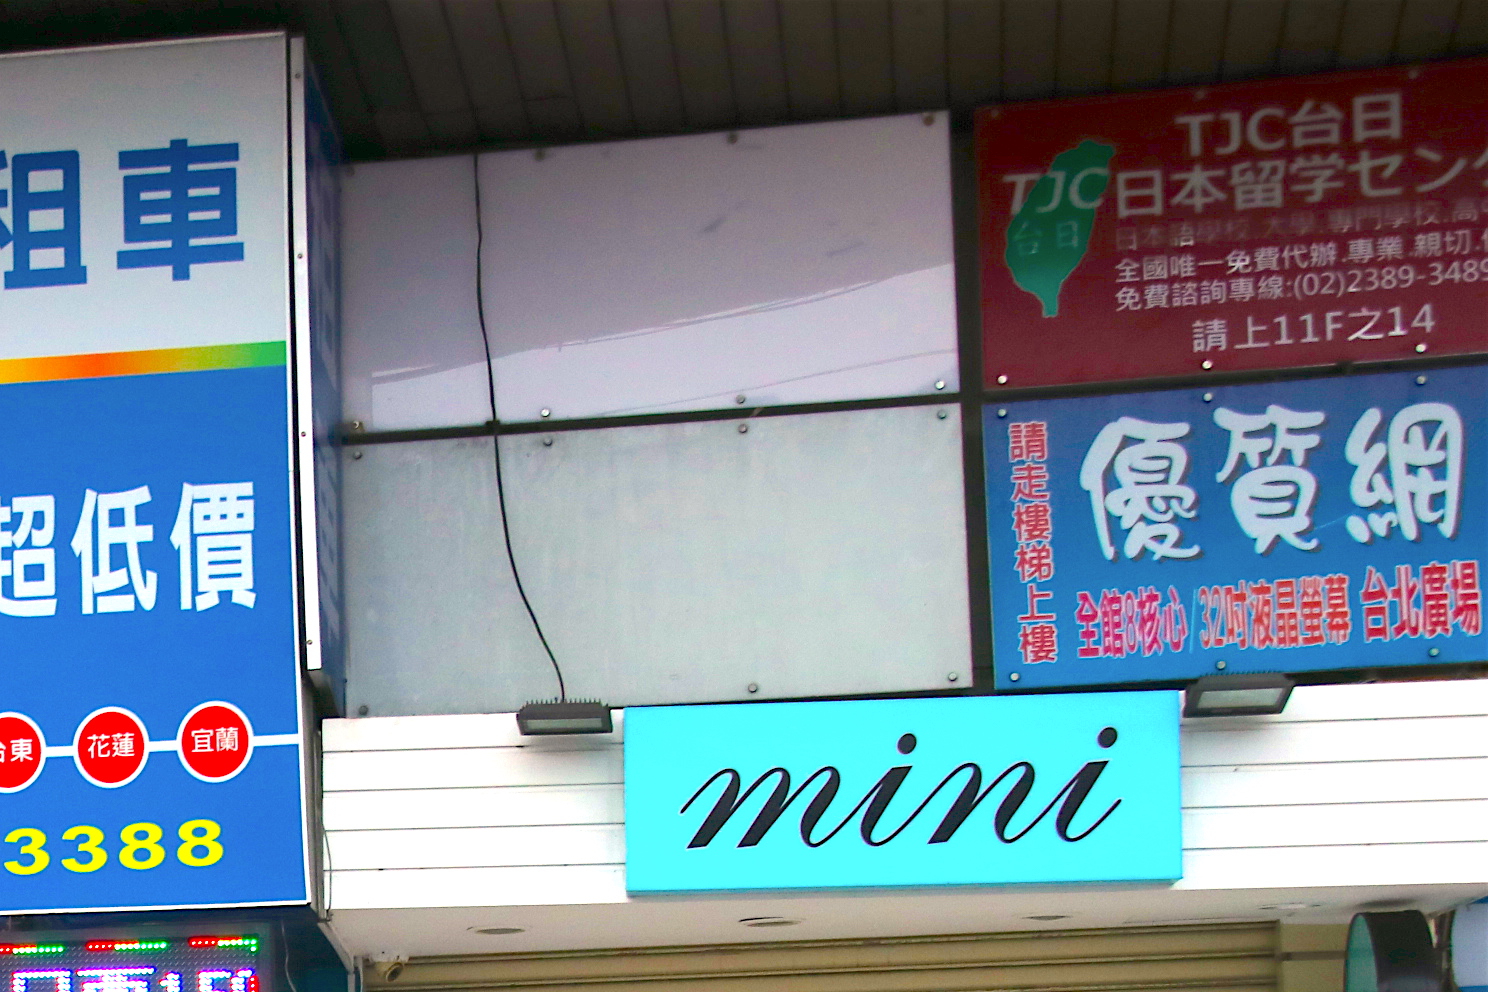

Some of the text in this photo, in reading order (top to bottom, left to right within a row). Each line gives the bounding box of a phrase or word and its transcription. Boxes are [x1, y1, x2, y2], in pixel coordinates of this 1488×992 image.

[1174, 91, 1404, 157] TJC台日
[1002, 167, 1110, 215] TJC
[1192, 303, 1436, 353] 請上11F之14
[1008, 421, 1057, 664] 請走樓梯上樓
[1359, 559, 1482, 643] 台北廣場
[86, 731, 137, 761] 花蓮
[190, 725, 240, 756] 宜蘭
[679, 726, 1122, 850] mini
